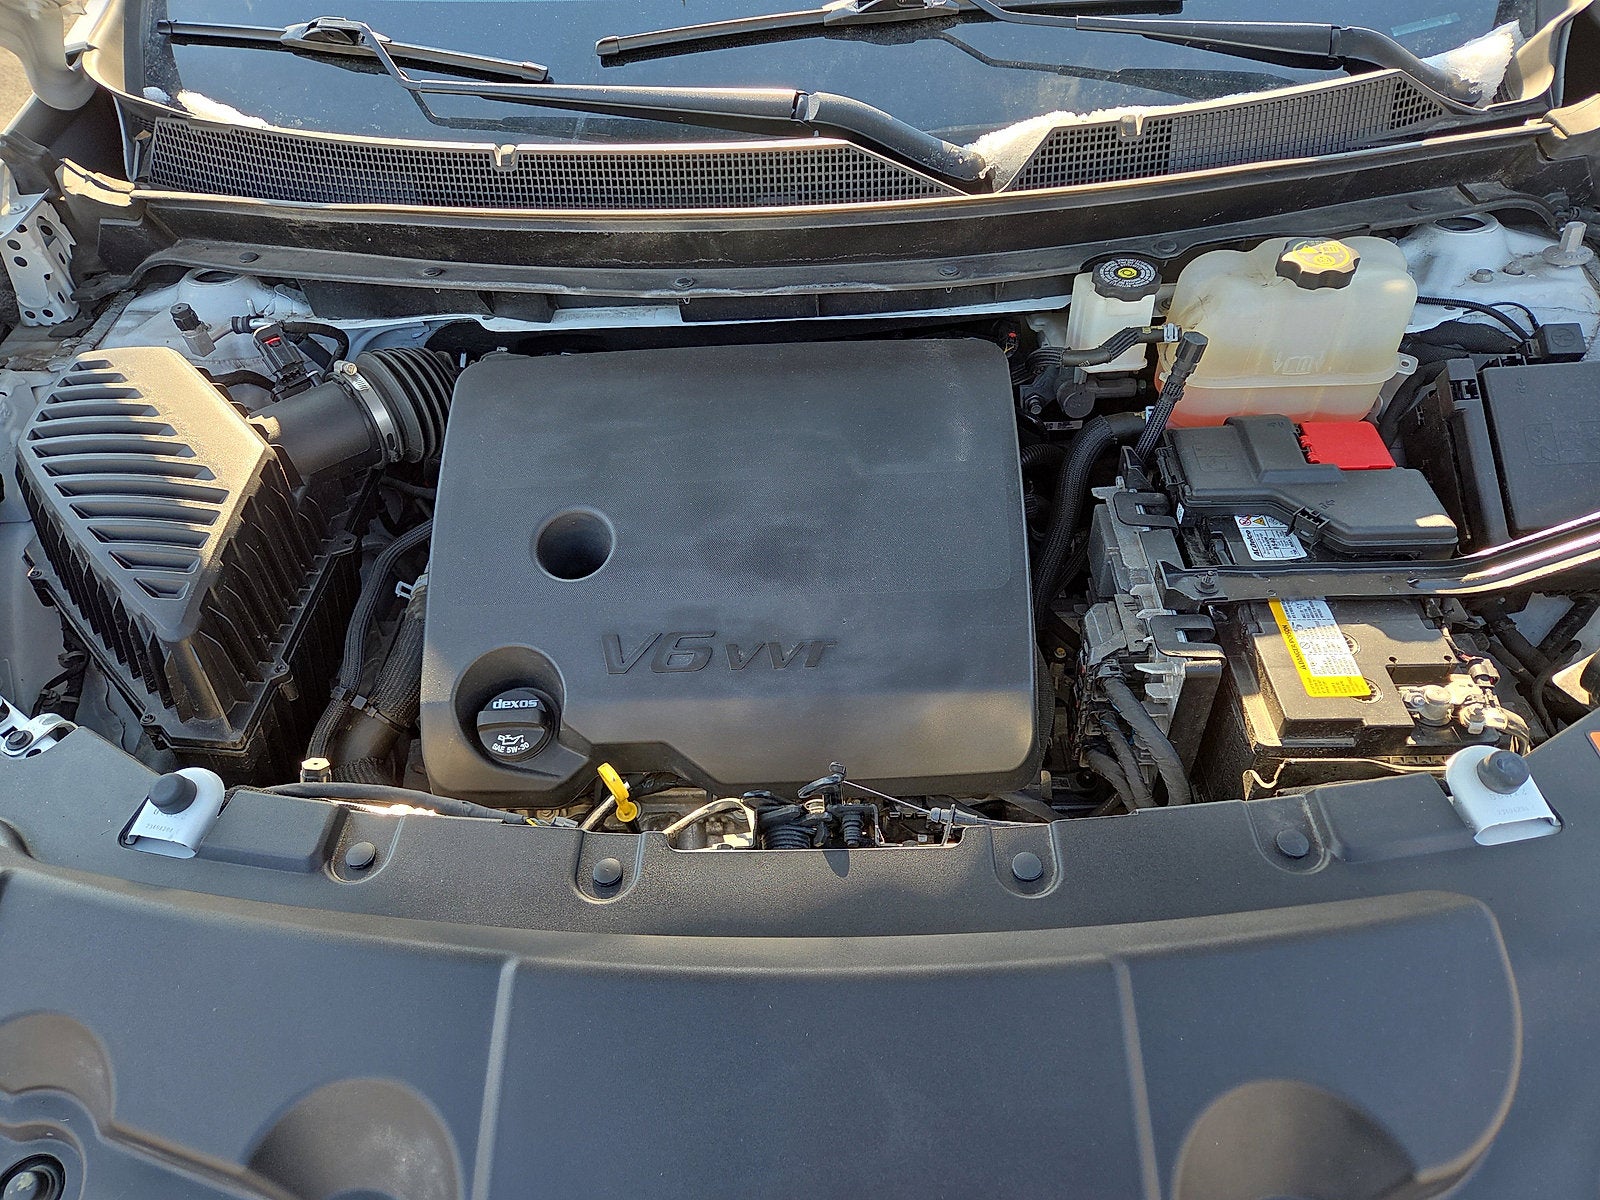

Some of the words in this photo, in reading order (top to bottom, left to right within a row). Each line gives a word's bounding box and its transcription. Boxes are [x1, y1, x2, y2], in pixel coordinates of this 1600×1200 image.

[601, 631, 716, 675] V6
[724, 639, 837, 671] VVT
[492, 698, 539, 710] dexos
[491, 742, 505, 753] SAE
[506, 742, 530, 754] 5W-30
